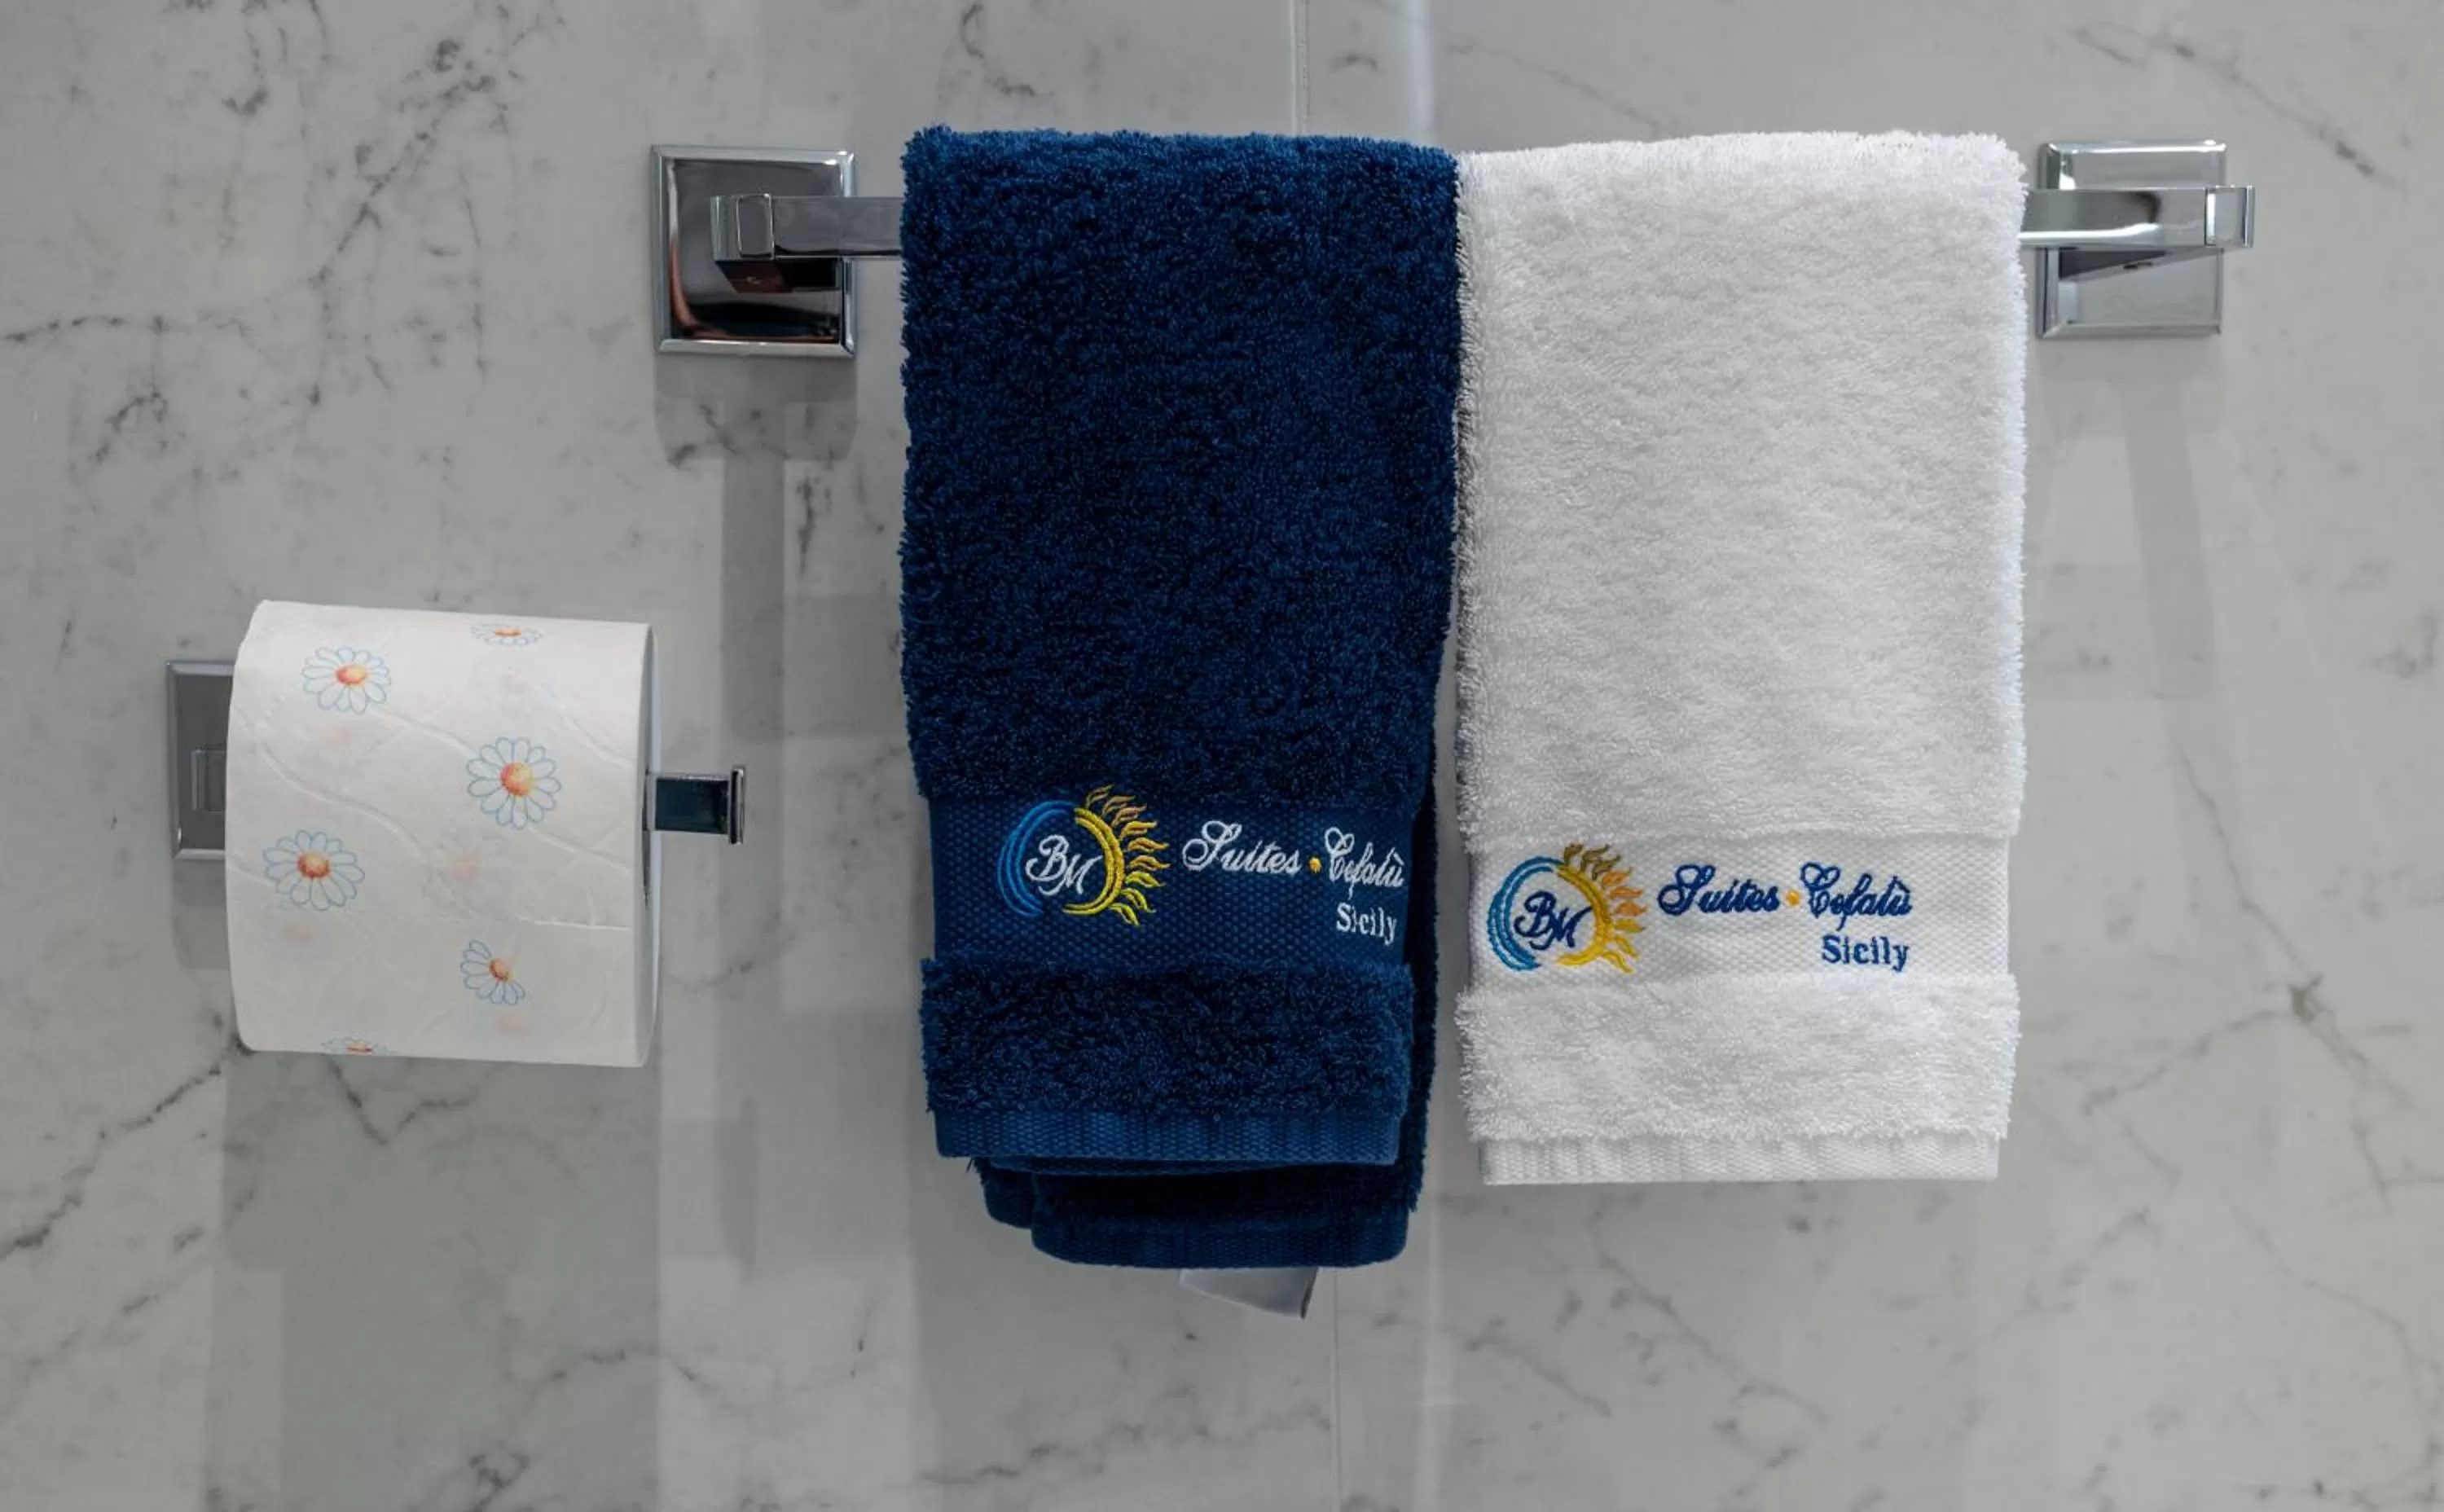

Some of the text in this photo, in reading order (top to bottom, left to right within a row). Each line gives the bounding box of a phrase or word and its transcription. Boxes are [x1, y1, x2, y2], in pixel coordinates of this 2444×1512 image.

[1182, 820, 1404, 899] Suites Cefalù
[1657, 863, 1913, 930] Suites Cefalù
[1336, 903, 1398, 946] Sicily
[1822, 934, 1910, 972] Sicily
